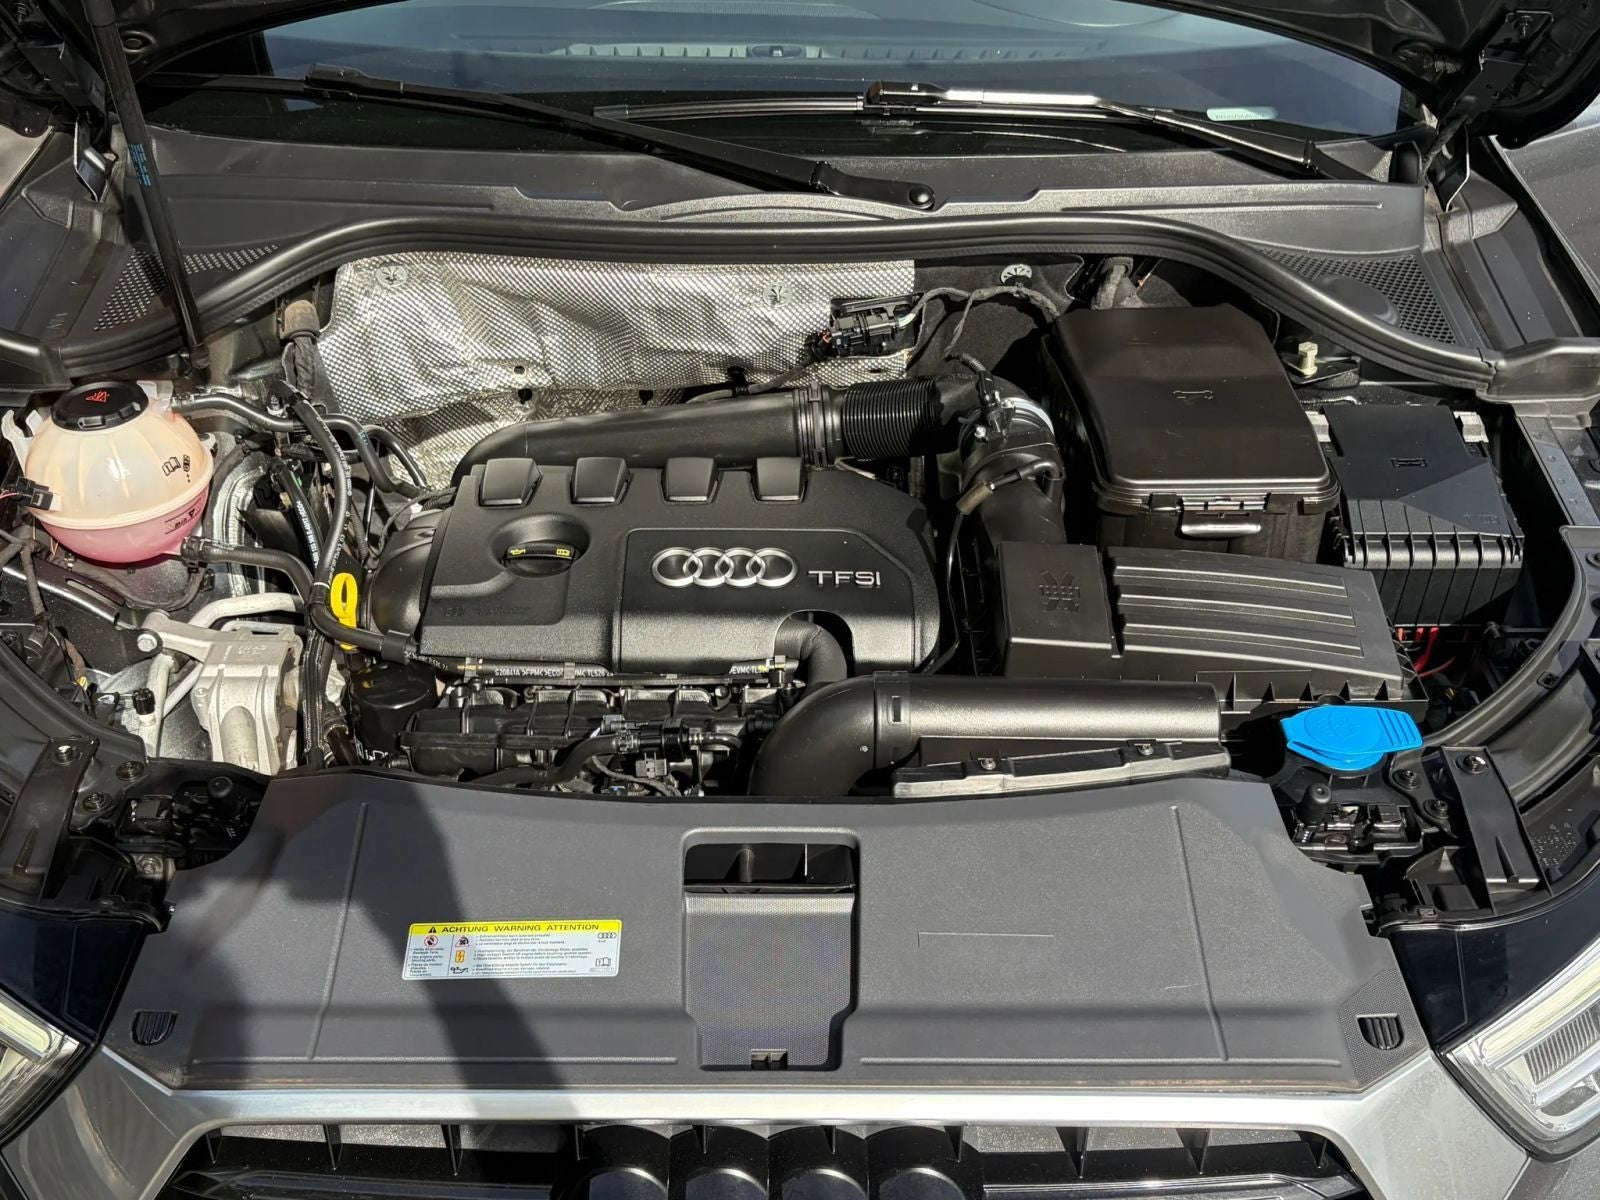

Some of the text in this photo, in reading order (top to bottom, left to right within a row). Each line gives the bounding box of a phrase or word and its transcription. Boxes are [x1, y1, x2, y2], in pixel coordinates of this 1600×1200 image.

[808, 570, 881, 586] TFSI
[441, 923, 600, 933] ACHTUNG WARNING ATTENTION
